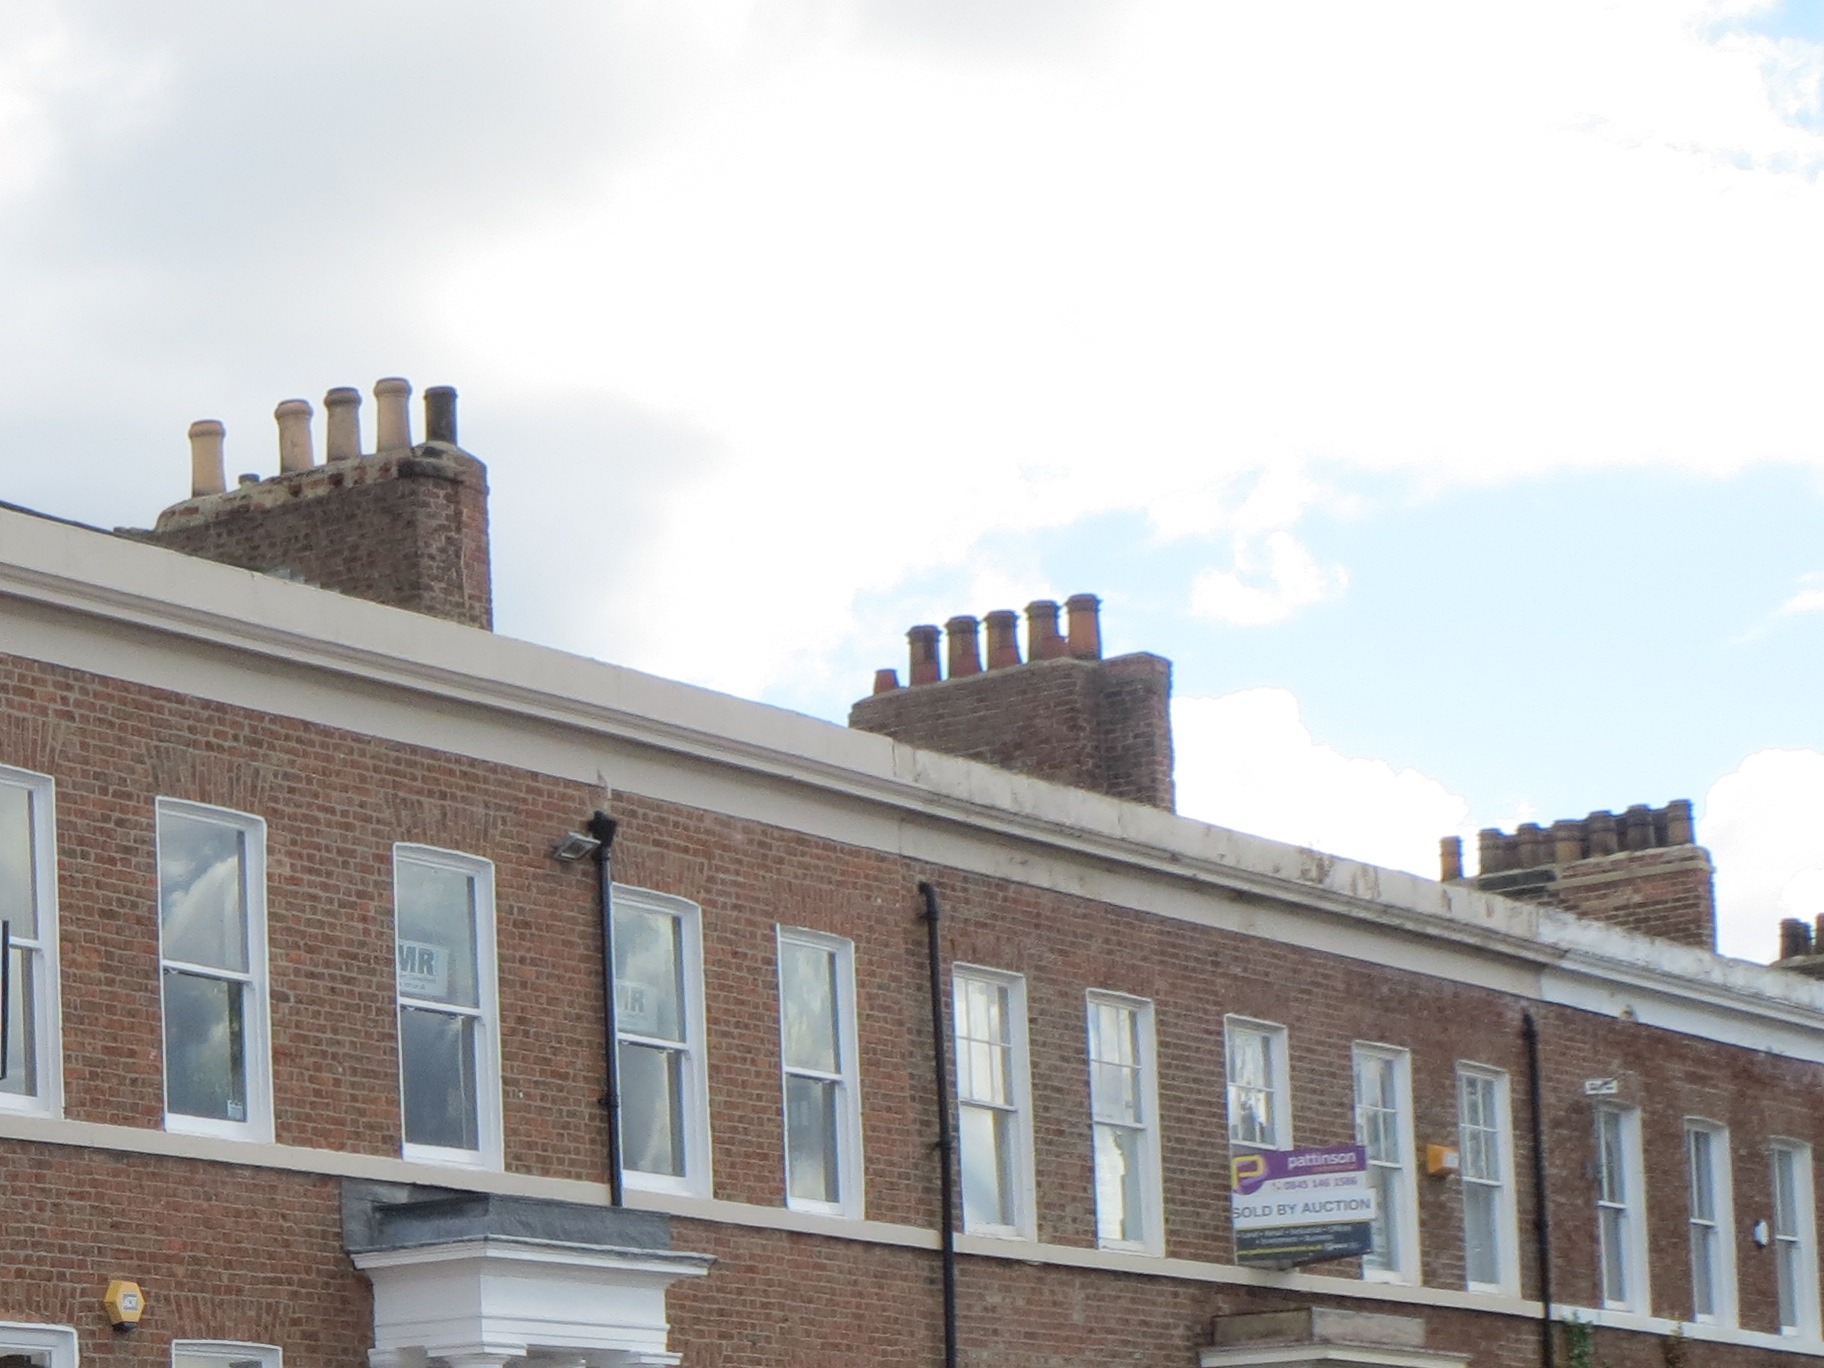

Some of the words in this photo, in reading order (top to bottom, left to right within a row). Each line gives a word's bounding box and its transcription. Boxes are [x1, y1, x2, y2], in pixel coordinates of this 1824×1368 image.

[1287, 1152, 1356, 1171] pattinson
[1233, 1205, 1272, 1219] SOLD
[1277, 1203, 1297, 1216] BY
[1301, 1198, 1371, 1214] AUCTION
